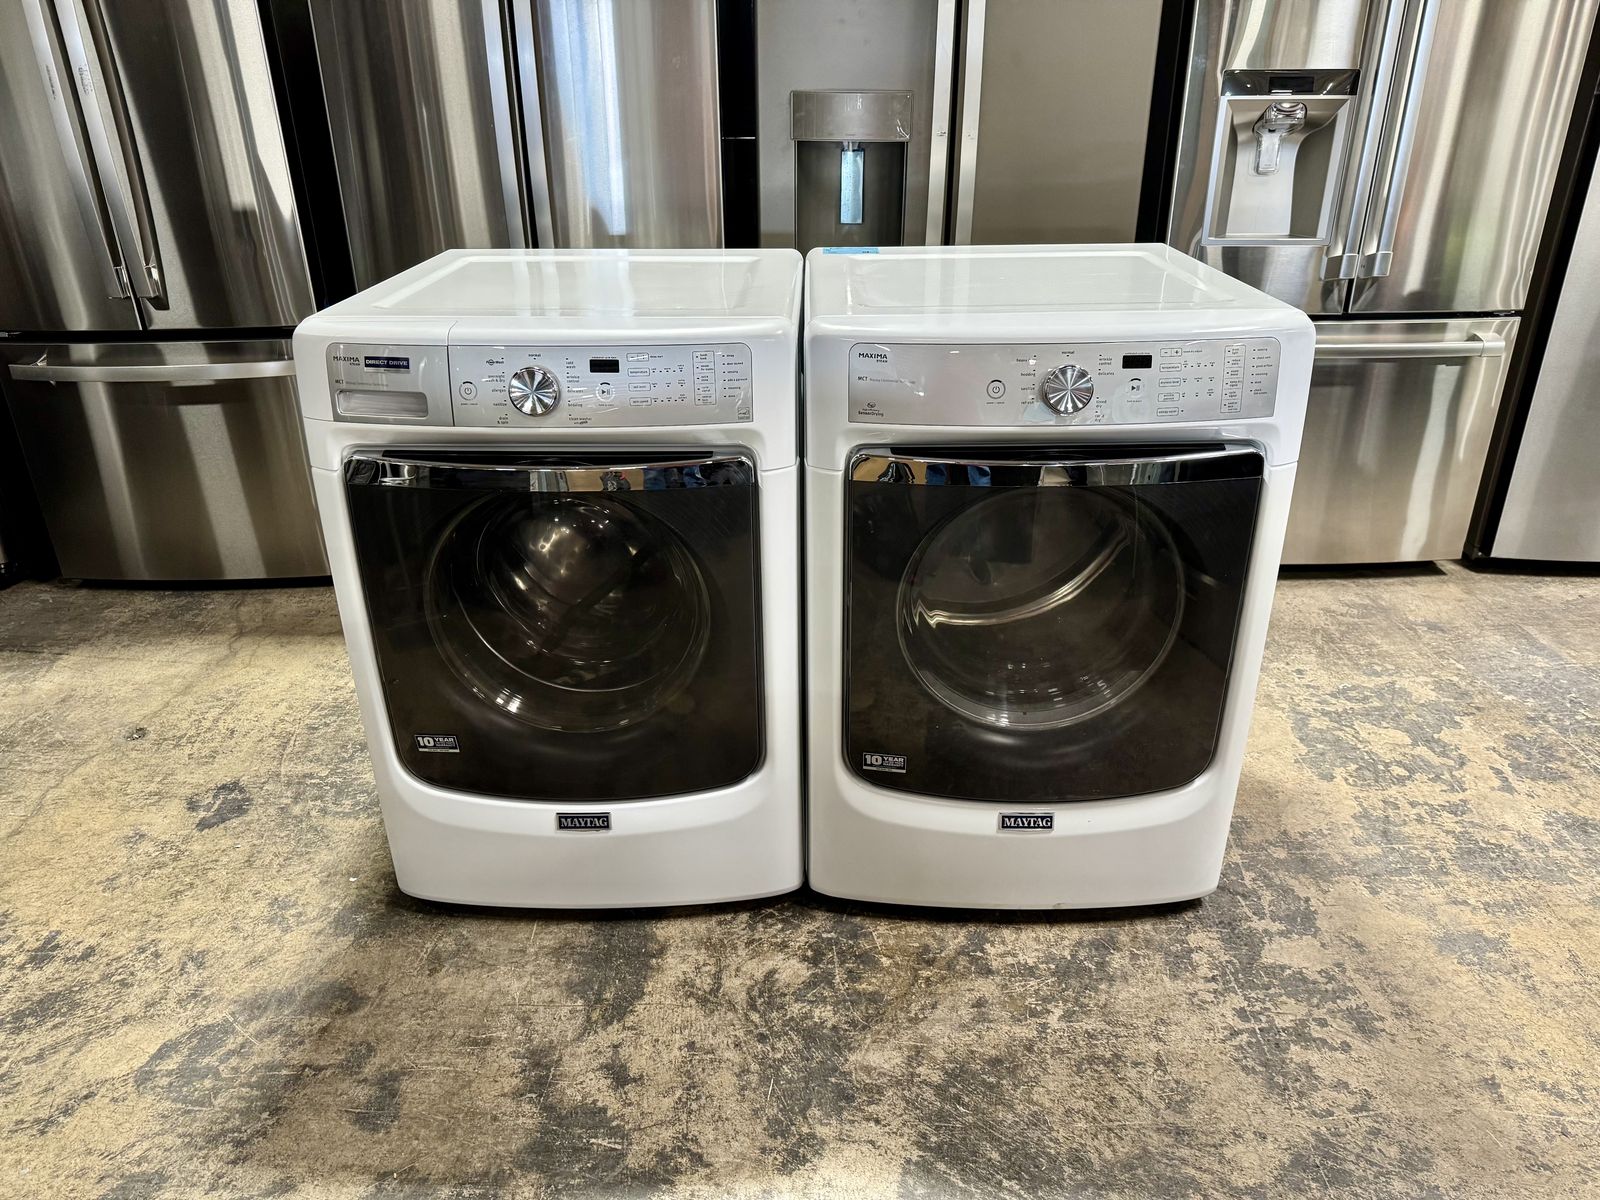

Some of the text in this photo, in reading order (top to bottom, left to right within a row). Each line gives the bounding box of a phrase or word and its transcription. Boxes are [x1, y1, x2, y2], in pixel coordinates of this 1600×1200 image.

[858, 352, 888, 360] MAXIMA
[417, 737, 434, 746] 10
[865, 755, 882, 765] 10
[560, 817, 608, 827] MAYTAG
[1003, 817, 1052, 827] MAYTAG
